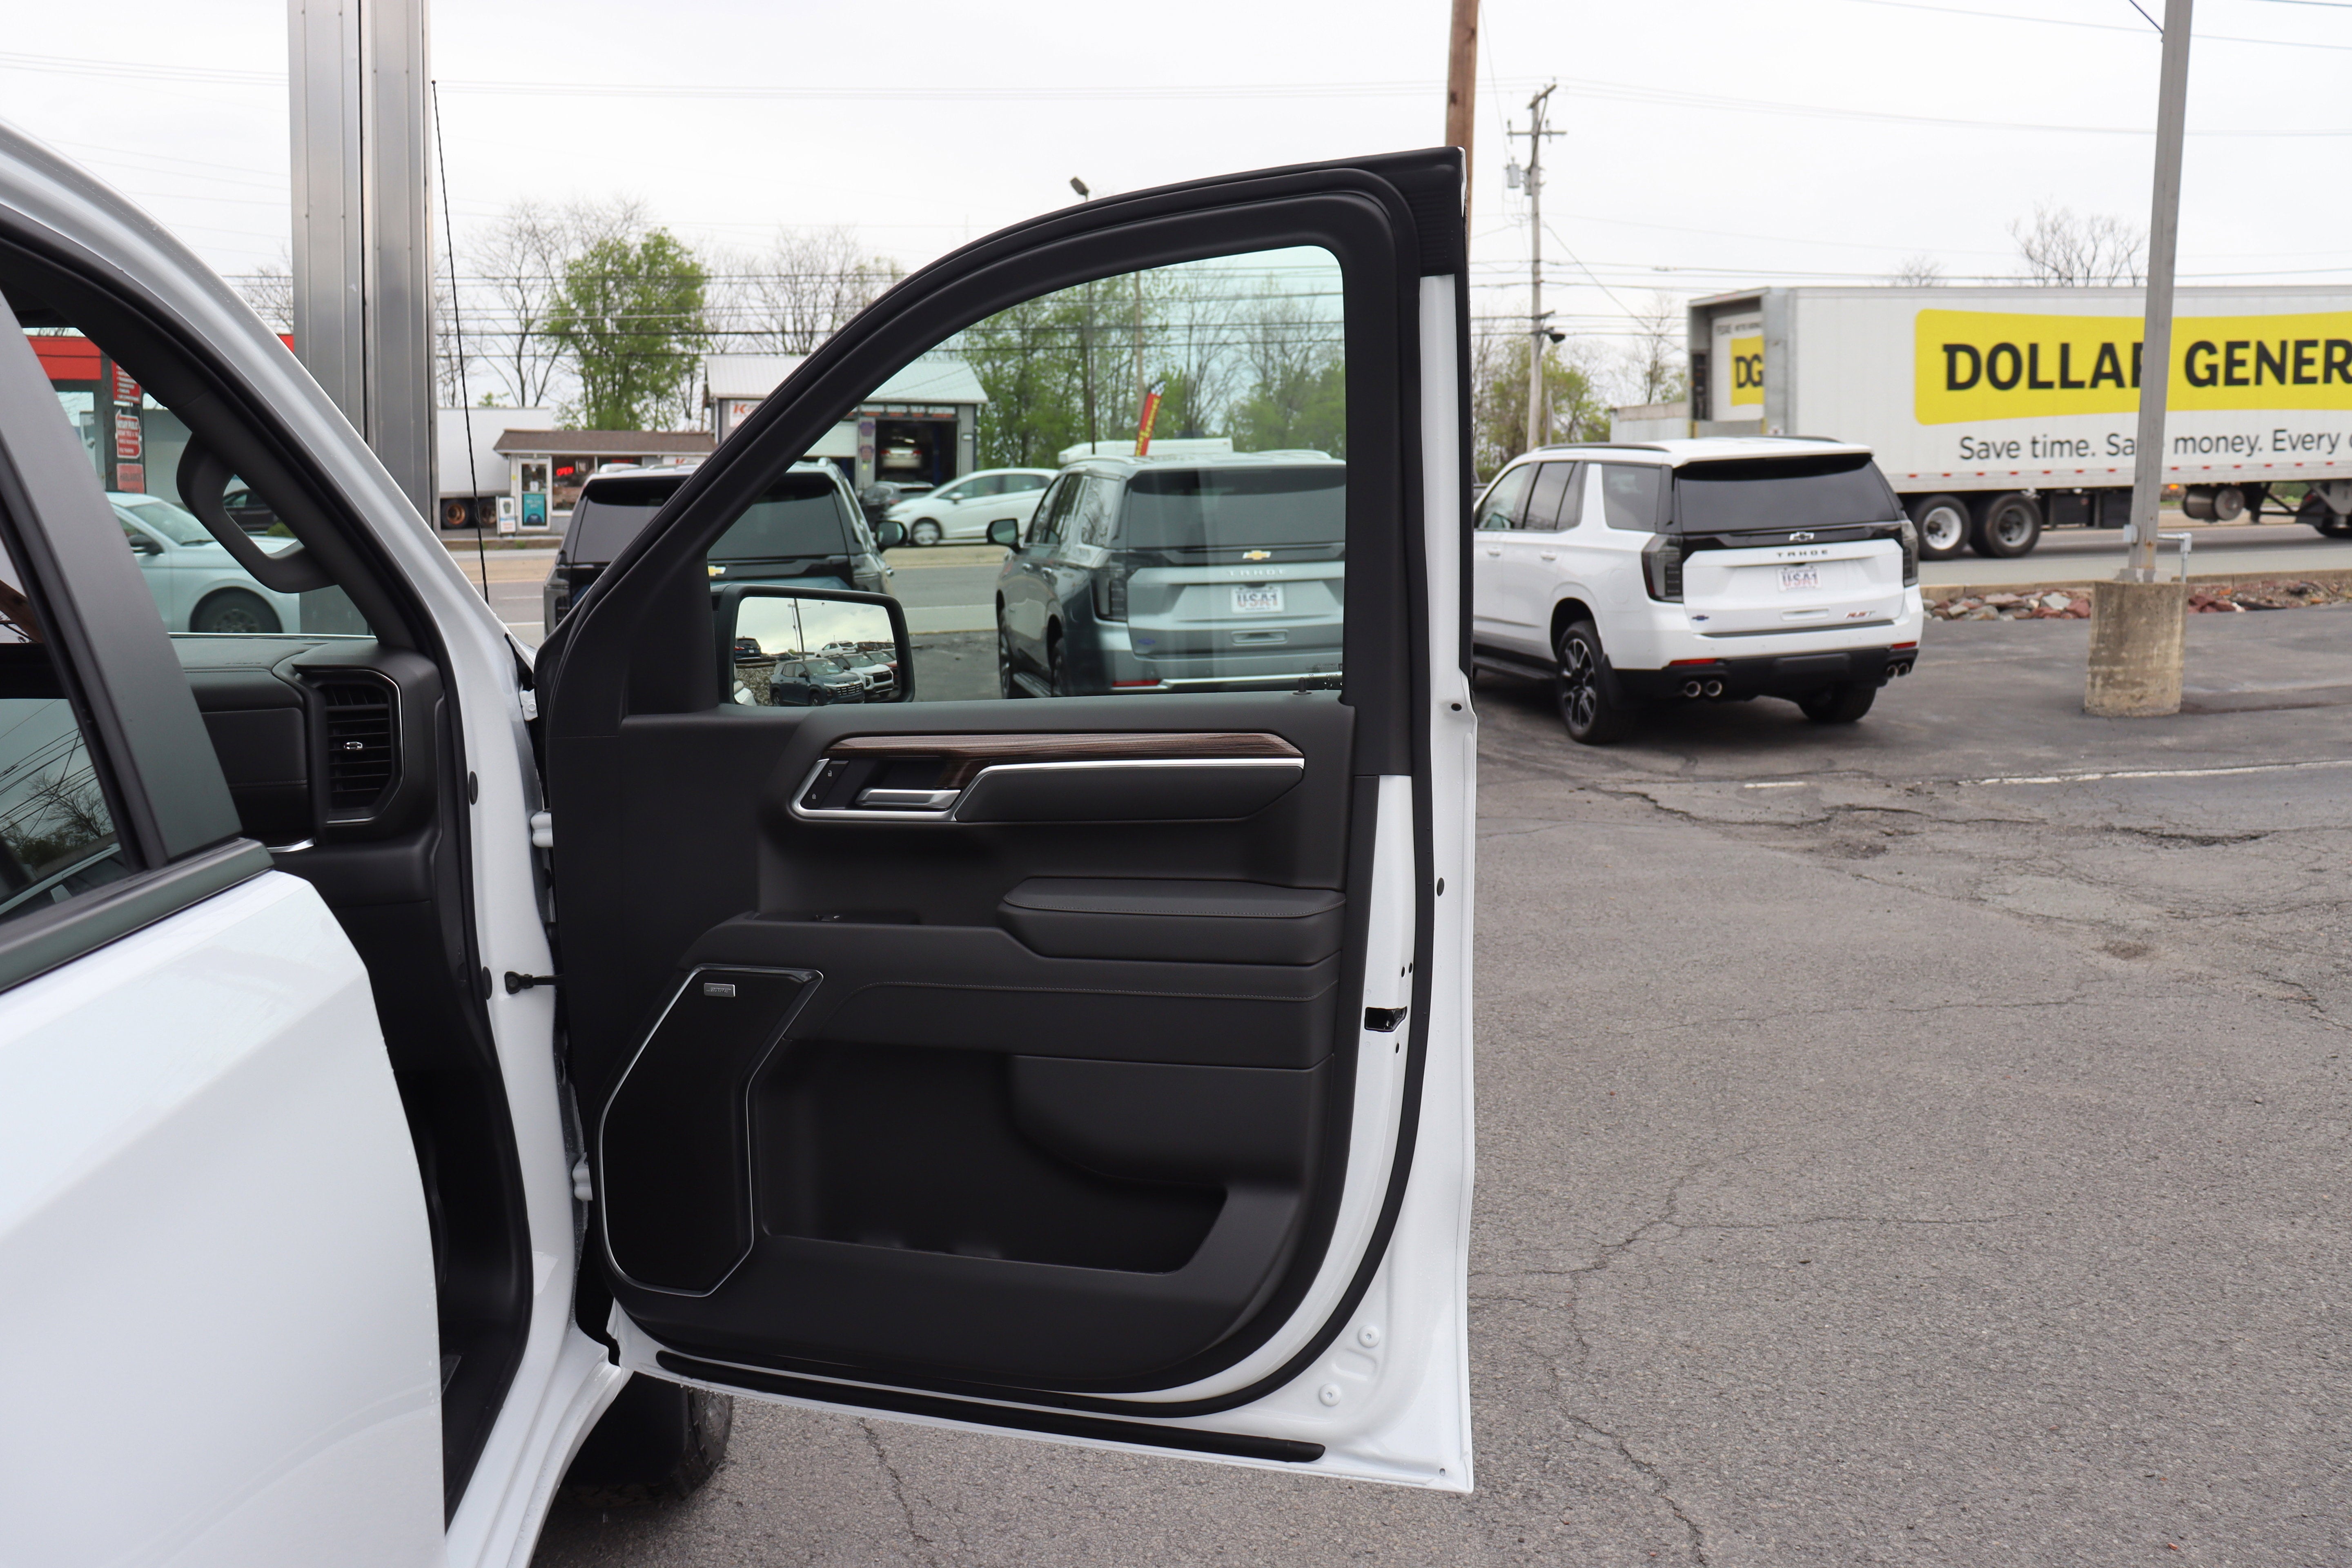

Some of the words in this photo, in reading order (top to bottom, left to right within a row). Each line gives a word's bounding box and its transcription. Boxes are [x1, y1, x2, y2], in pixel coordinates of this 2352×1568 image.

[1735, 354, 1763, 388] DG
[1960, 436, 2020, 460] Save
[2031, 434, 2096, 458] time.
[2106, 432, 2135, 457] Sa
[2174, 433, 2263, 458] money.
[2272, 429, 2341, 455] Every
[1777, 549, 1828, 557] TAHOE
[1782, 572, 1818, 587] USA1
[1237, 593, 1278, 607] USA1
